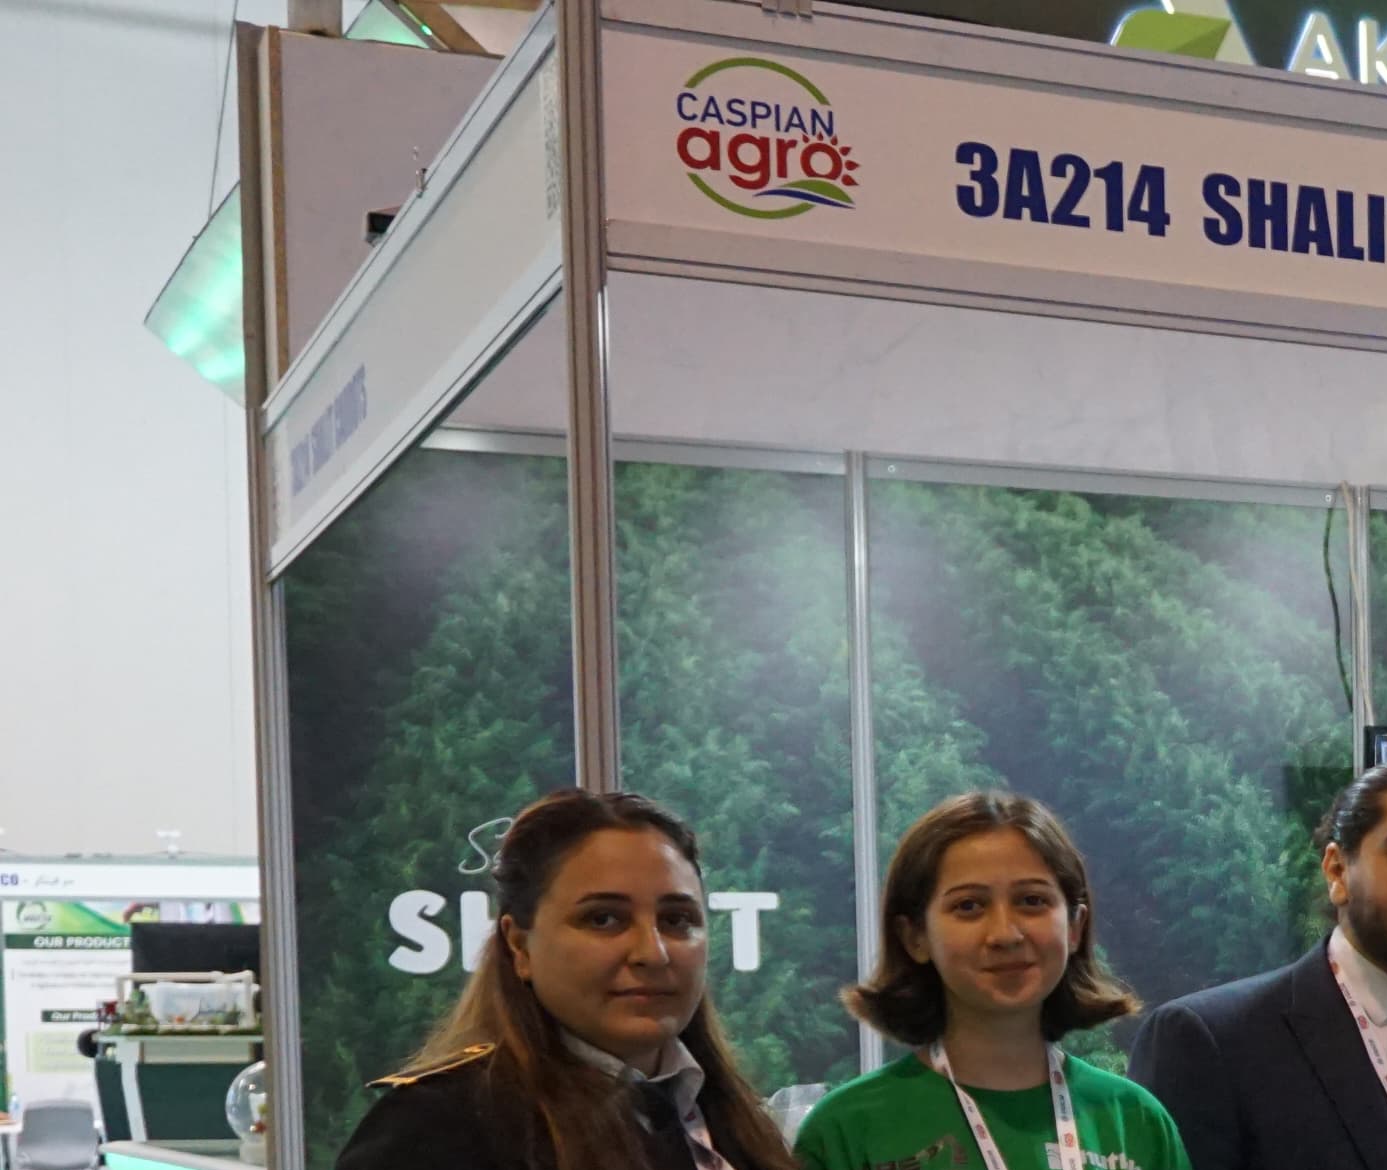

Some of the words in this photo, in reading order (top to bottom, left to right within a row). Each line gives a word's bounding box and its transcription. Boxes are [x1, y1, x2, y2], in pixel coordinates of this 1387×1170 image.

[676, 92, 834, 137] CASPIAN
[676, 127, 843, 190] agro
[956, 140, 1171, 237] 3A214
